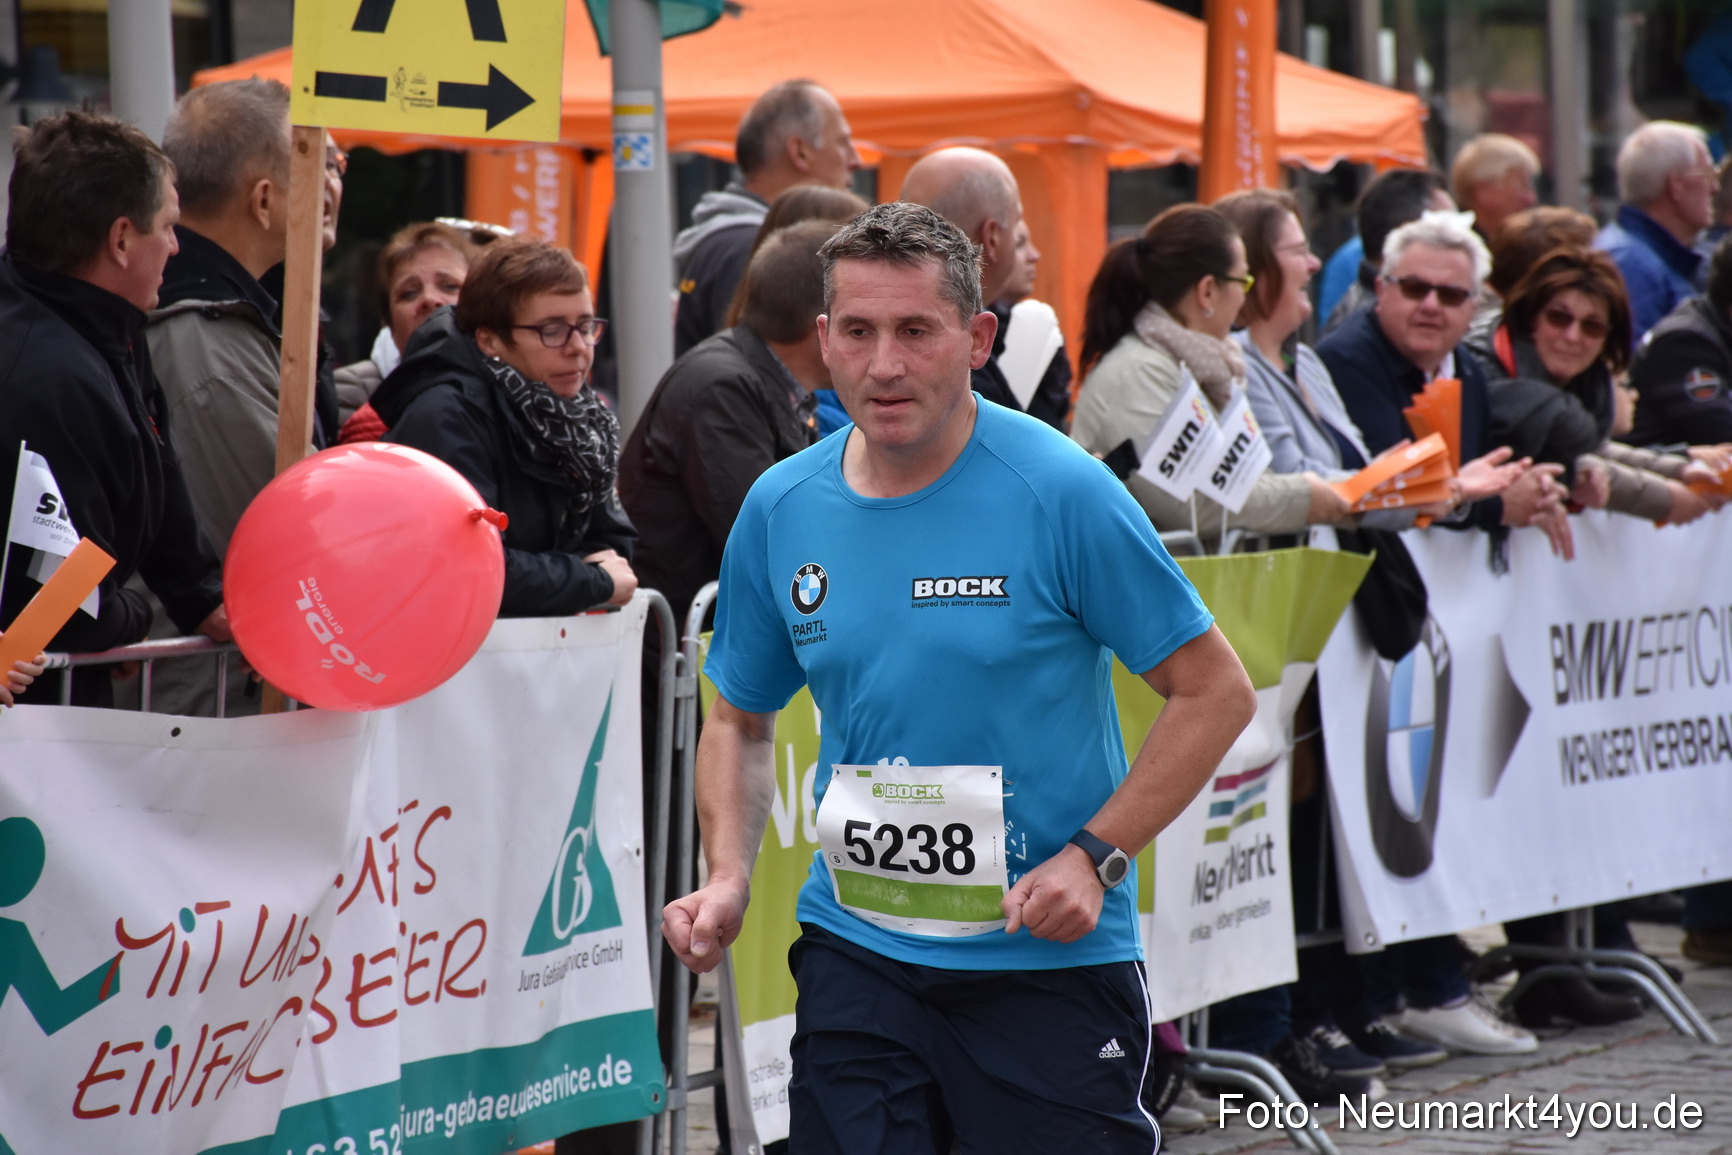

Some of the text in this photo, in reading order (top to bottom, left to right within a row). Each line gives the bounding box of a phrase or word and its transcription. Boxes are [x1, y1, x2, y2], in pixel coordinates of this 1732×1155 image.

[1158, 420, 1200, 479] swn
[1211, 432, 1251, 491] swn
[795, 564, 826, 584] BMW
[913, 577, 1008, 599] BOCK
[911, 600, 939, 609] inspired
[940, 600, 950, 608] by
[975, 600, 1011, 608] concepts
[296, 580, 388, 684] RÖDL
[792, 619, 828, 637] PARTL
[795, 632, 828, 647] Neumarkt
[1549, 605, 1732, 707] BMW EFFICI
[1557, 713, 1732, 788] WENIGER VERBRA
[885, 784, 944, 799] BOCK
[844, 819, 976, 876] 5238
[518, 969, 541, 992] Jura
[592, 939, 623, 967] GmbH
[1099, 1049, 1126, 1059] adidas
